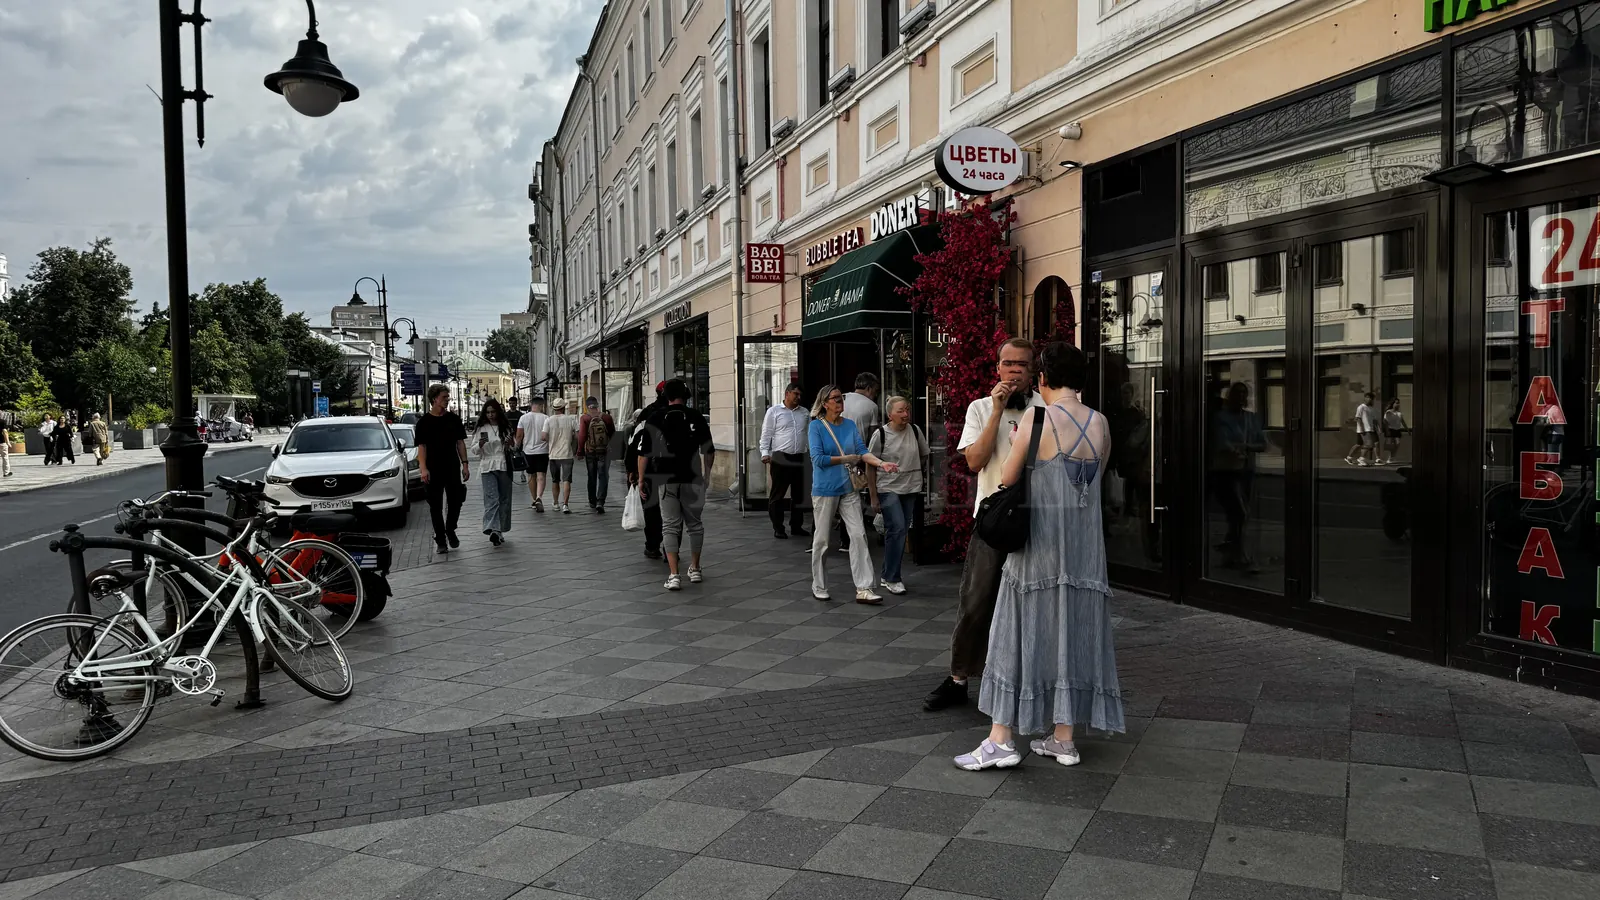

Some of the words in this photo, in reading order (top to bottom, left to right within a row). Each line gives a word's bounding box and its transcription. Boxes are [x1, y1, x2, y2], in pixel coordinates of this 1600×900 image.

[949, 144, 1017, 165] ЦВЕТЫ
[962, 168, 976, 179] 24
[979, 171, 1005, 181] часа
[750, 246, 781, 259] BAO
[805, 236, 838, 266] BUBBLE
[840, 227, 861, 254] TEA
[750, 259, 781, 274] BEI
[839, 285, 865, 308] MANIA
[1517, 298, 1567, 647] ТАБАК
